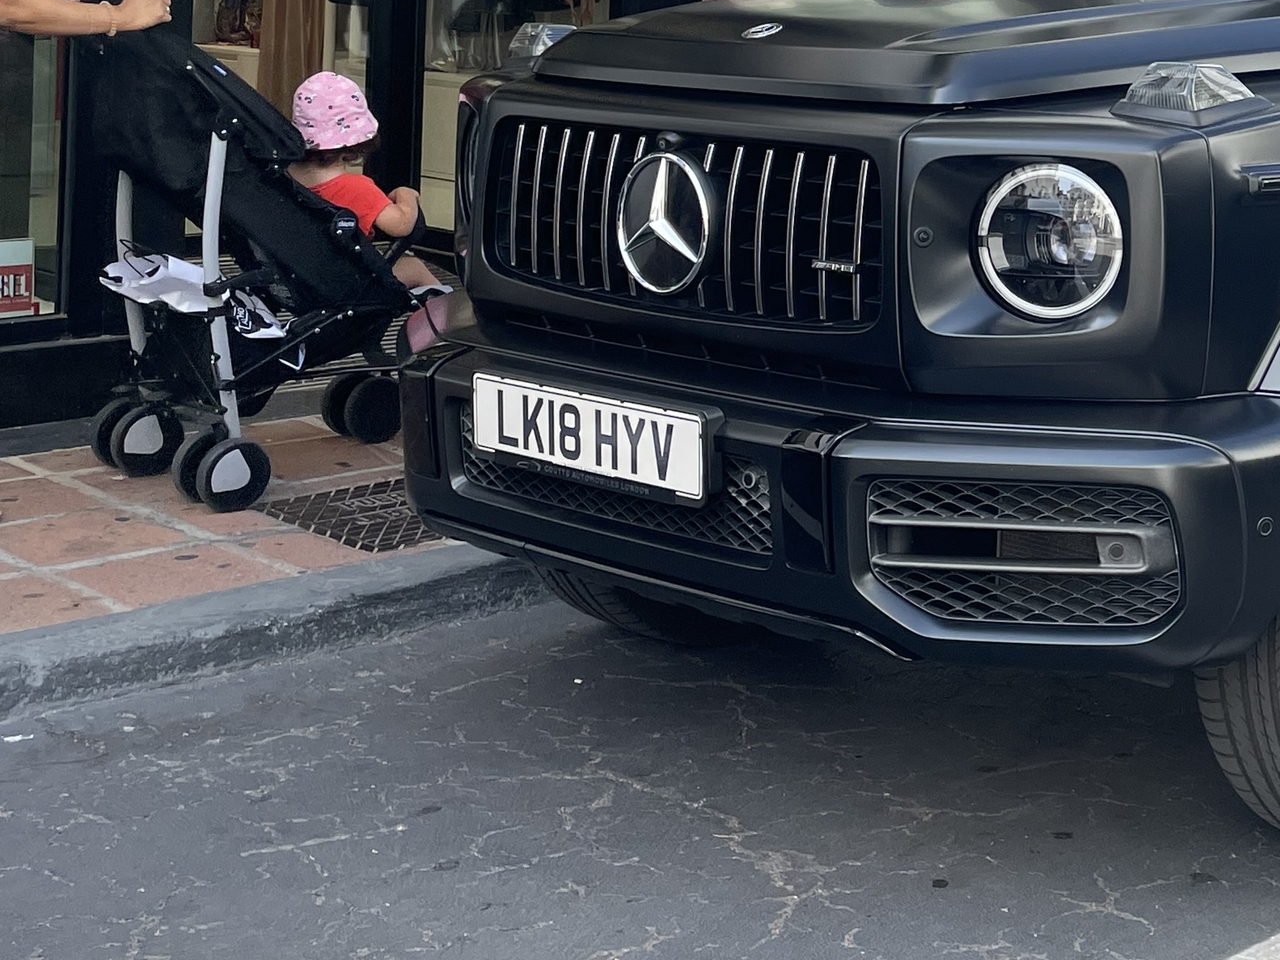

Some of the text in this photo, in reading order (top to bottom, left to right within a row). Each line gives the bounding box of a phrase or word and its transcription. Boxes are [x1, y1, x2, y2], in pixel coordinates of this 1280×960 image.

[496, 388, 675, 482] LK18 HYV
[544, 465, 570, 478] COUTTS
[571, 471, 620, 490] AUTOMOBILES
[620, 480, 650, 496] LONDON
